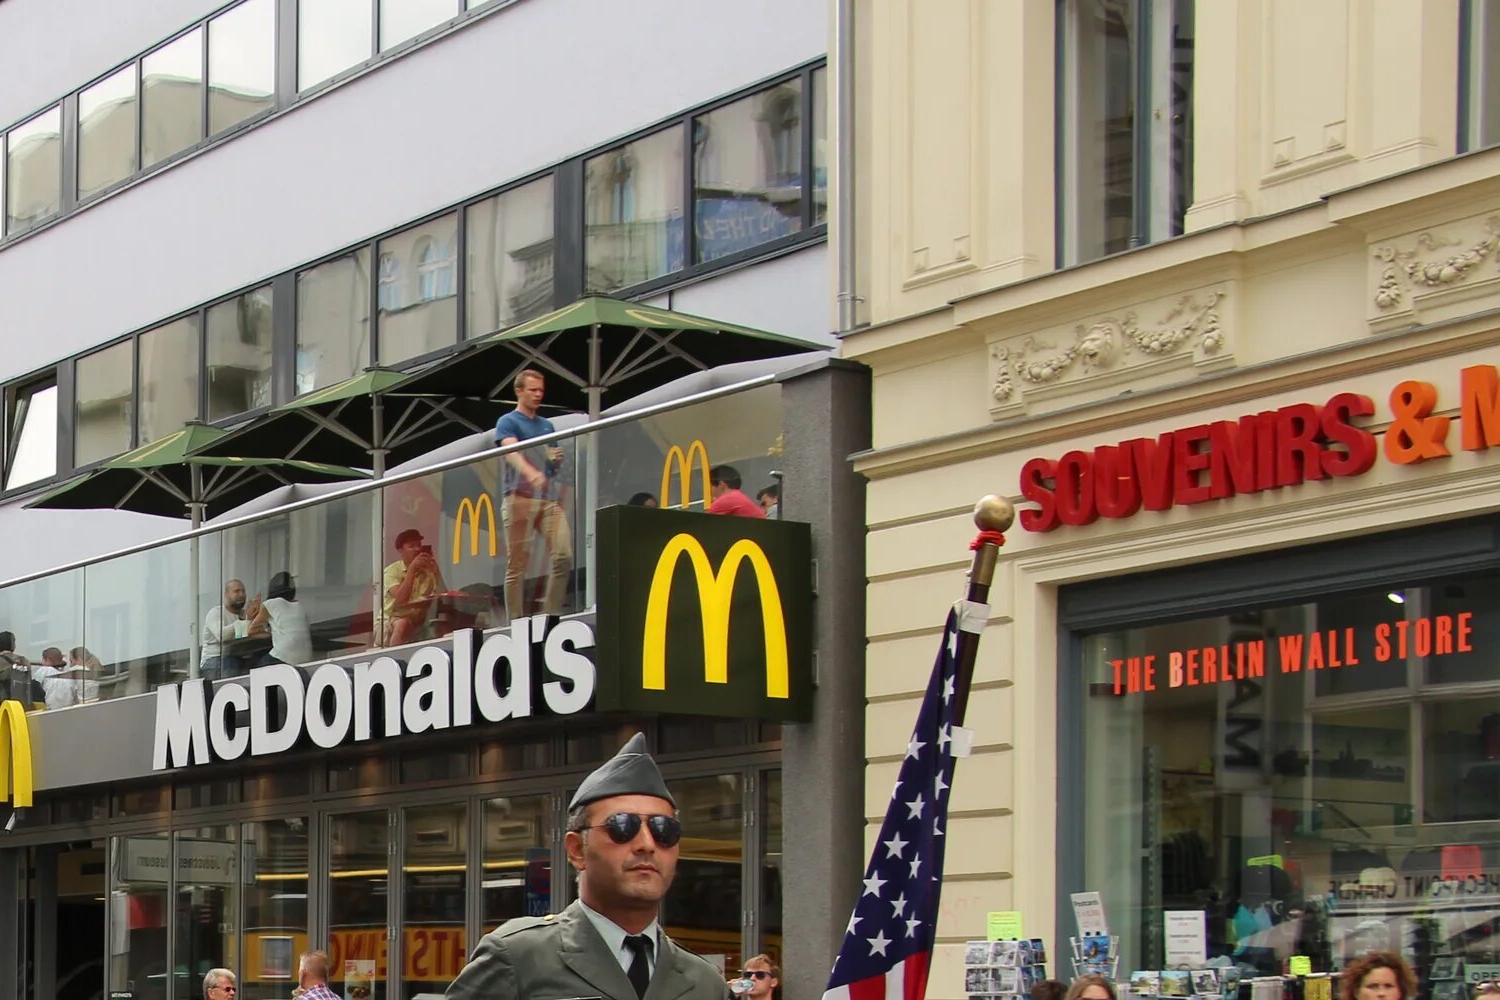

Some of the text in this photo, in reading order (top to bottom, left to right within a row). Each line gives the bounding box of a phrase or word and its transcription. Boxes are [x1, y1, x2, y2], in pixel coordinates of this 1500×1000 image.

[1019, 392, 1378, 533] SOUVENIRS
[1384, 380, 1452, 465] &
[153, 612, 596, 771] McDonald's
[1111, 612, 1473, 697] THE BERLIN WALL STORE
